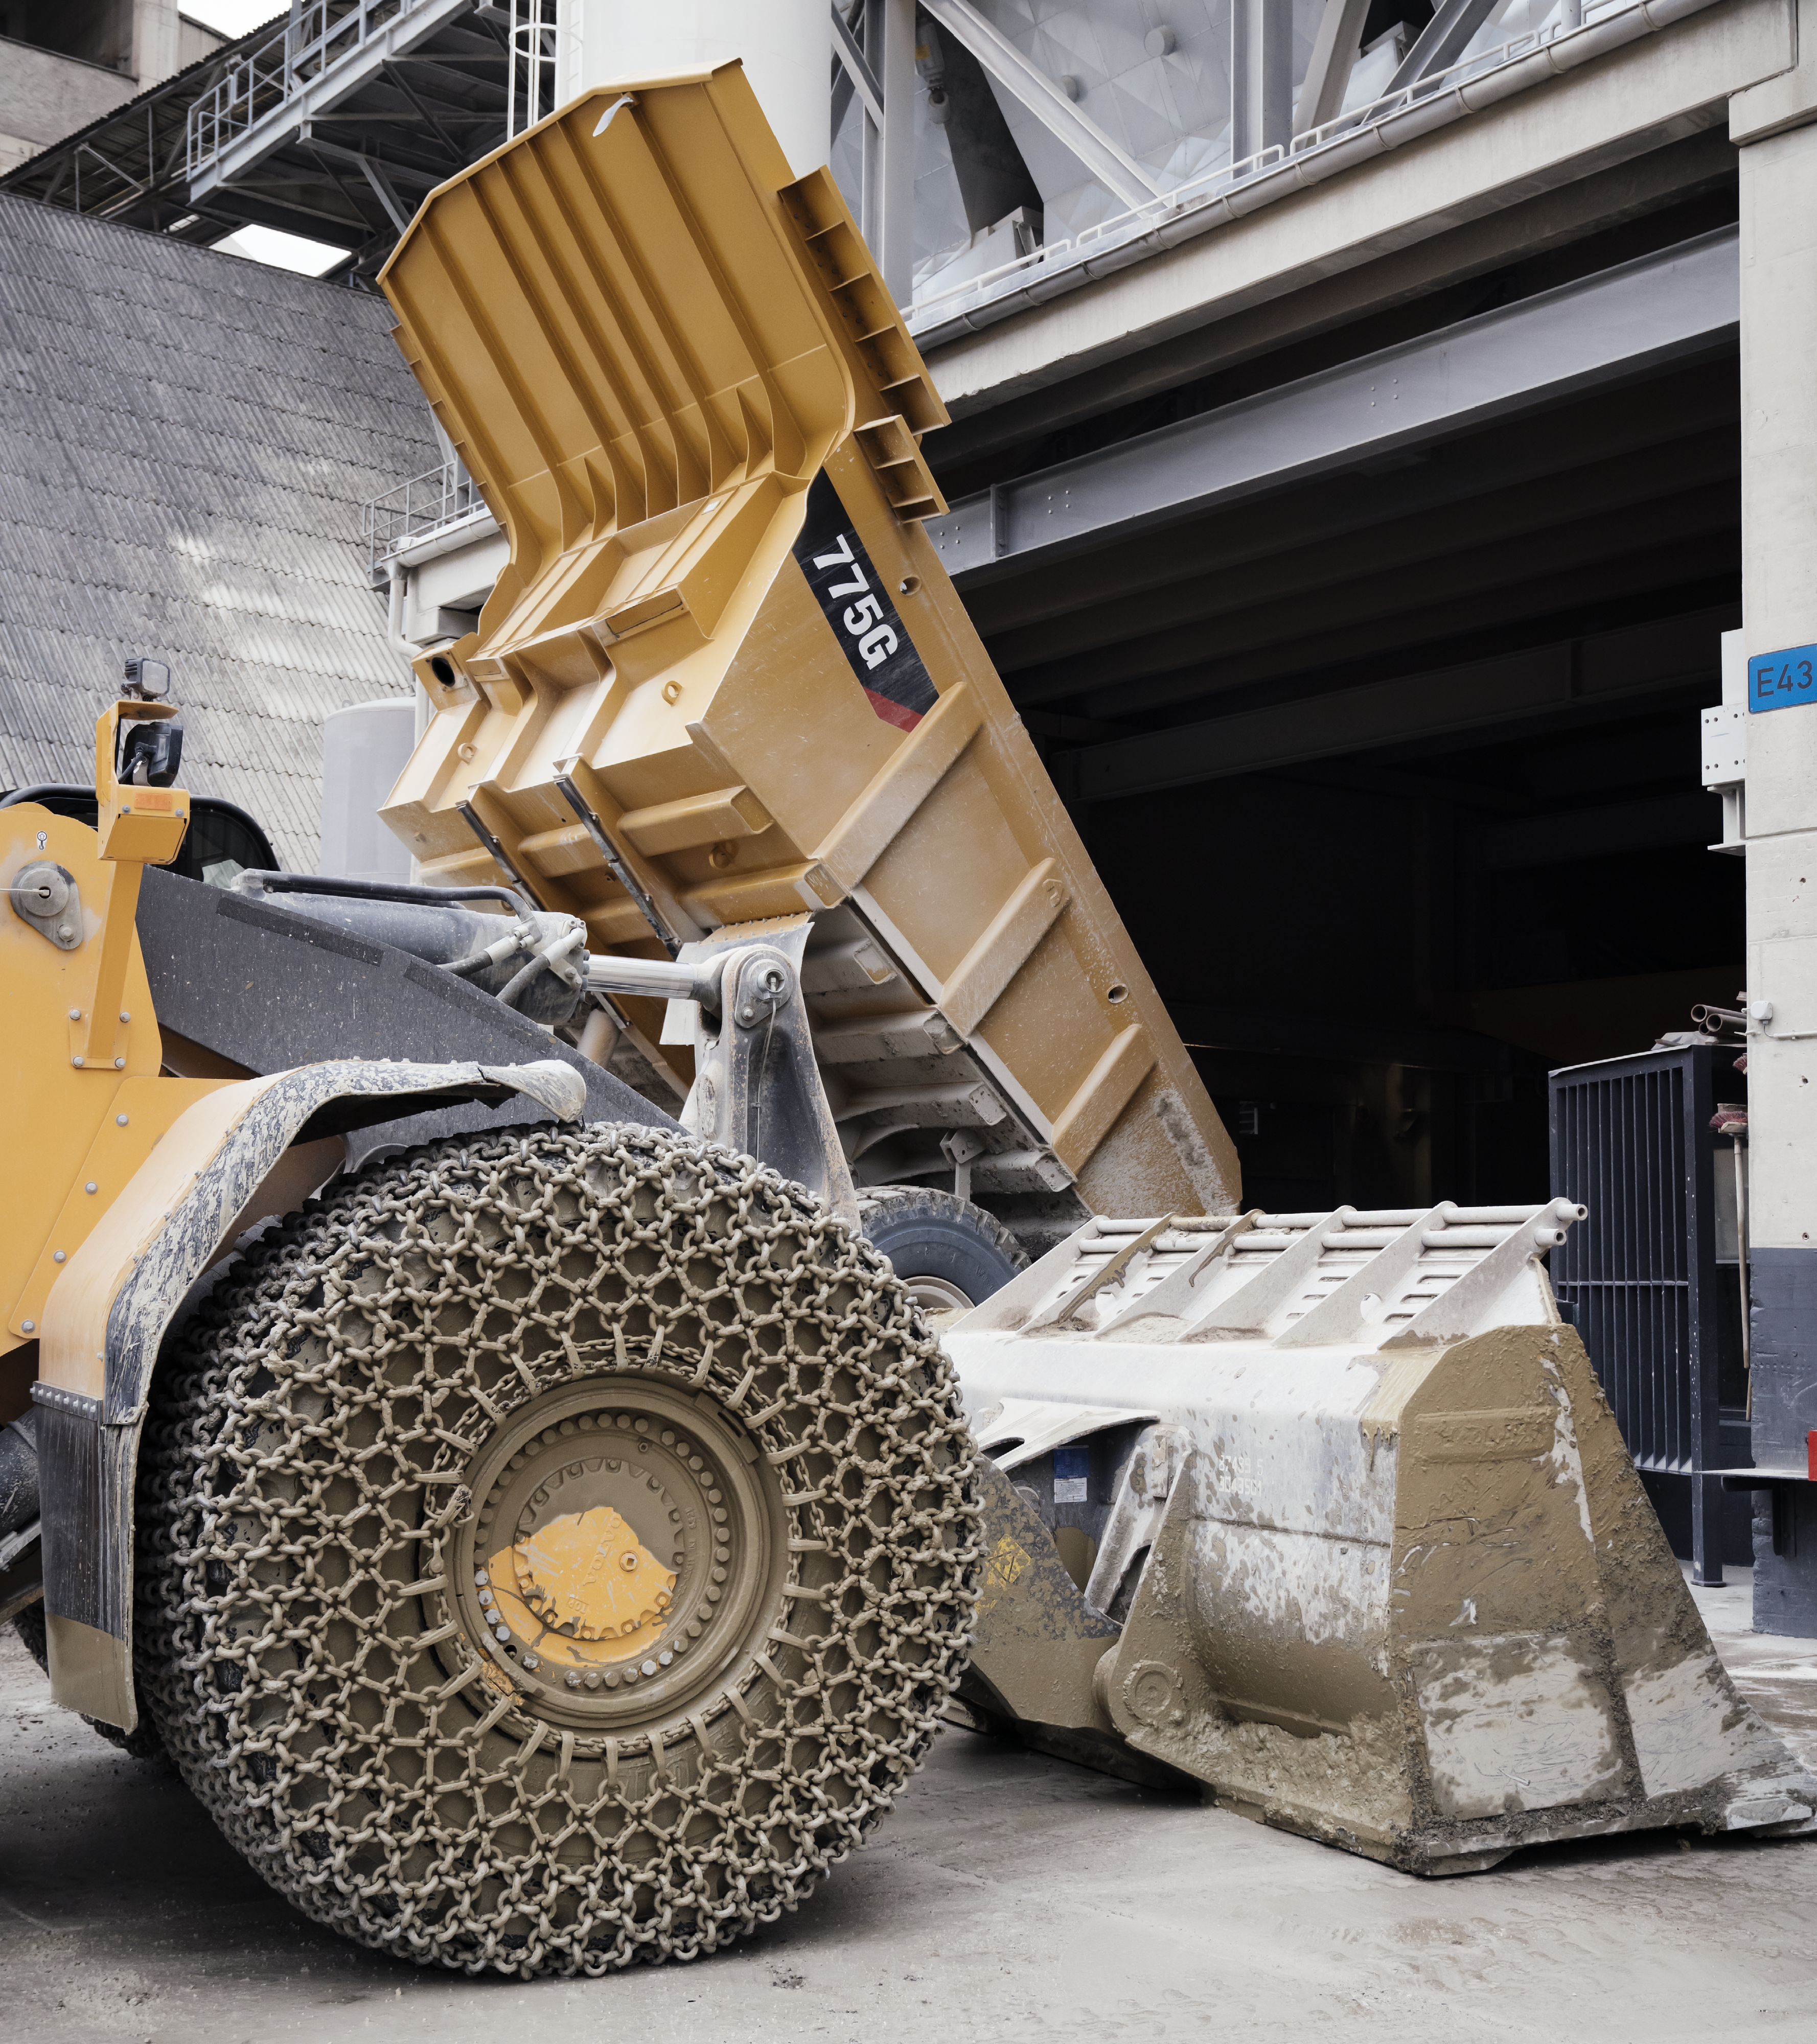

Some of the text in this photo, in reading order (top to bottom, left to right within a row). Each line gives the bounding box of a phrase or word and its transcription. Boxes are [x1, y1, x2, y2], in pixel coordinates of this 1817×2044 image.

[813, 534, 898, 670] 775G
[1757, 660, 1812, 698] E43
[1257, 1458, 1263, 1476] 5
[1218, 1475, 1262, 1497] 3043501
[582, 1511, 622, 1586] VOLVO
[568, 1599, 587, 1615] TOP
